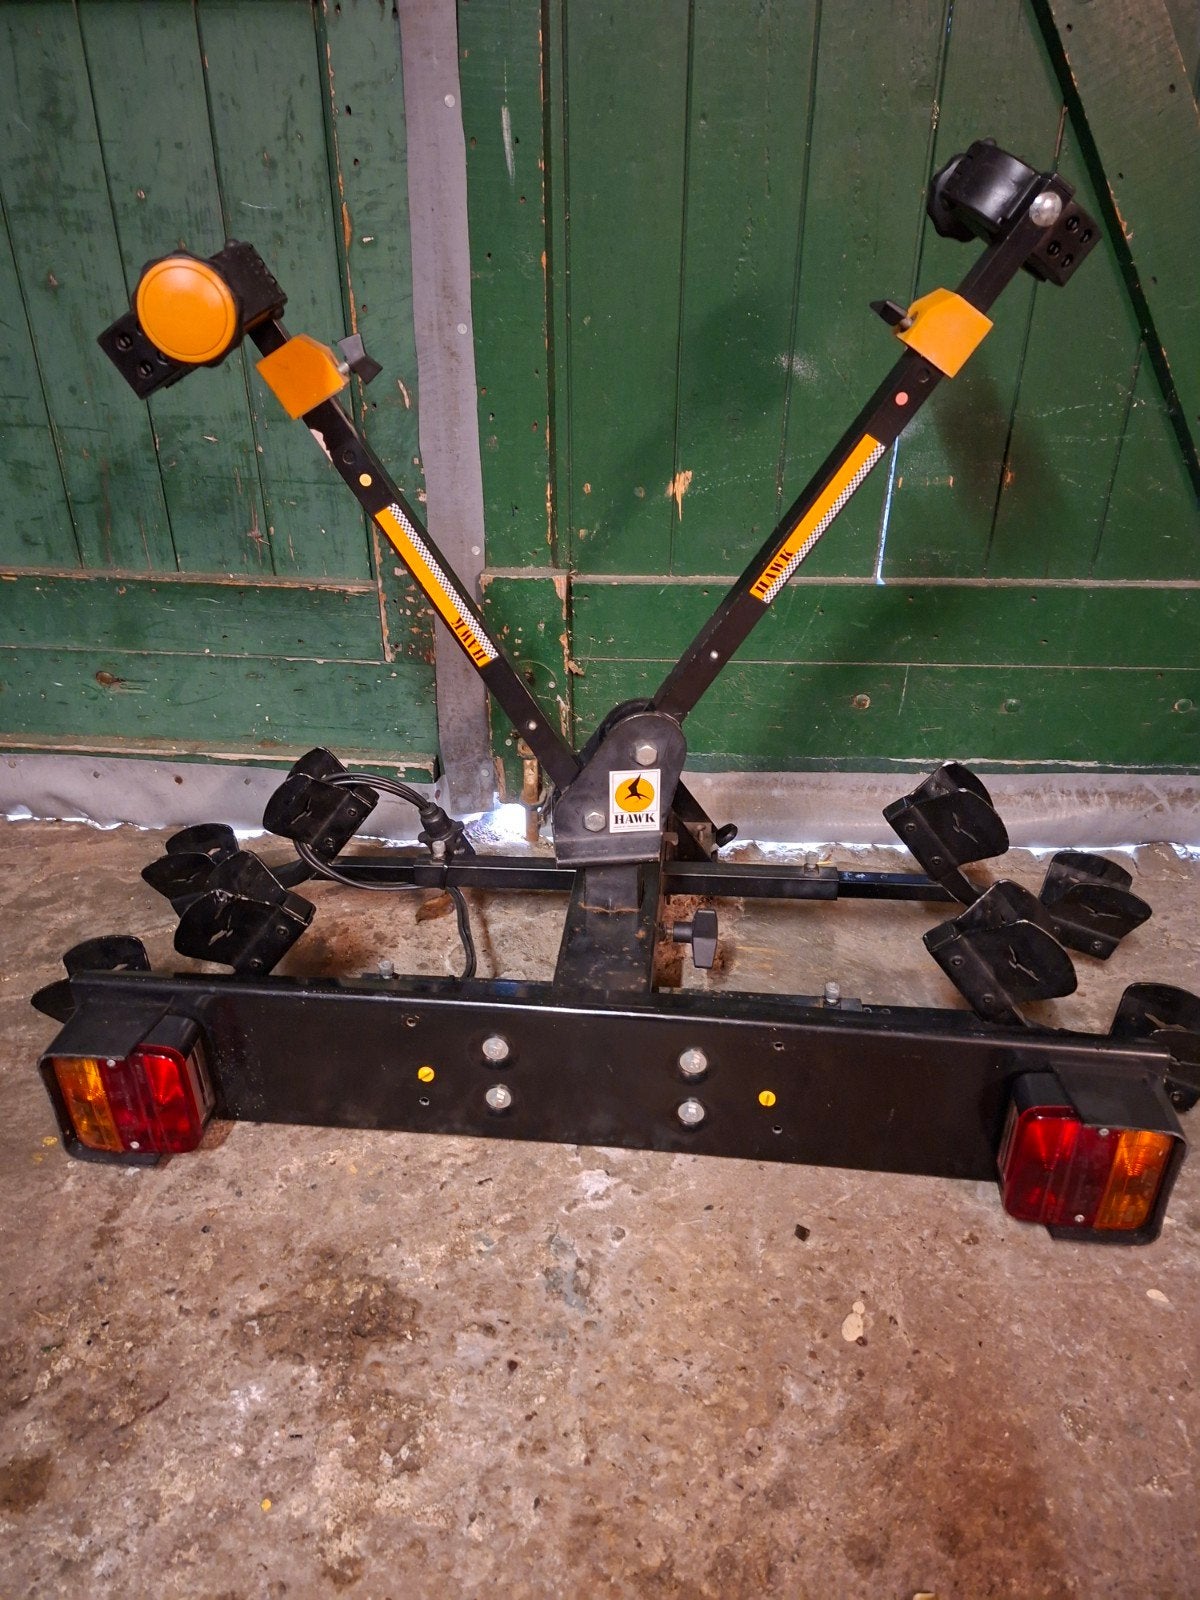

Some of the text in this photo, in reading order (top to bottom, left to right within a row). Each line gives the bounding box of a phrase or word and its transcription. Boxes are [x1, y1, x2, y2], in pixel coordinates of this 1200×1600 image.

[754, 549, 794, 594] HAWK
[451, 617, 487, 661] HAWK
[614, 812, 656, 825] HAWK
